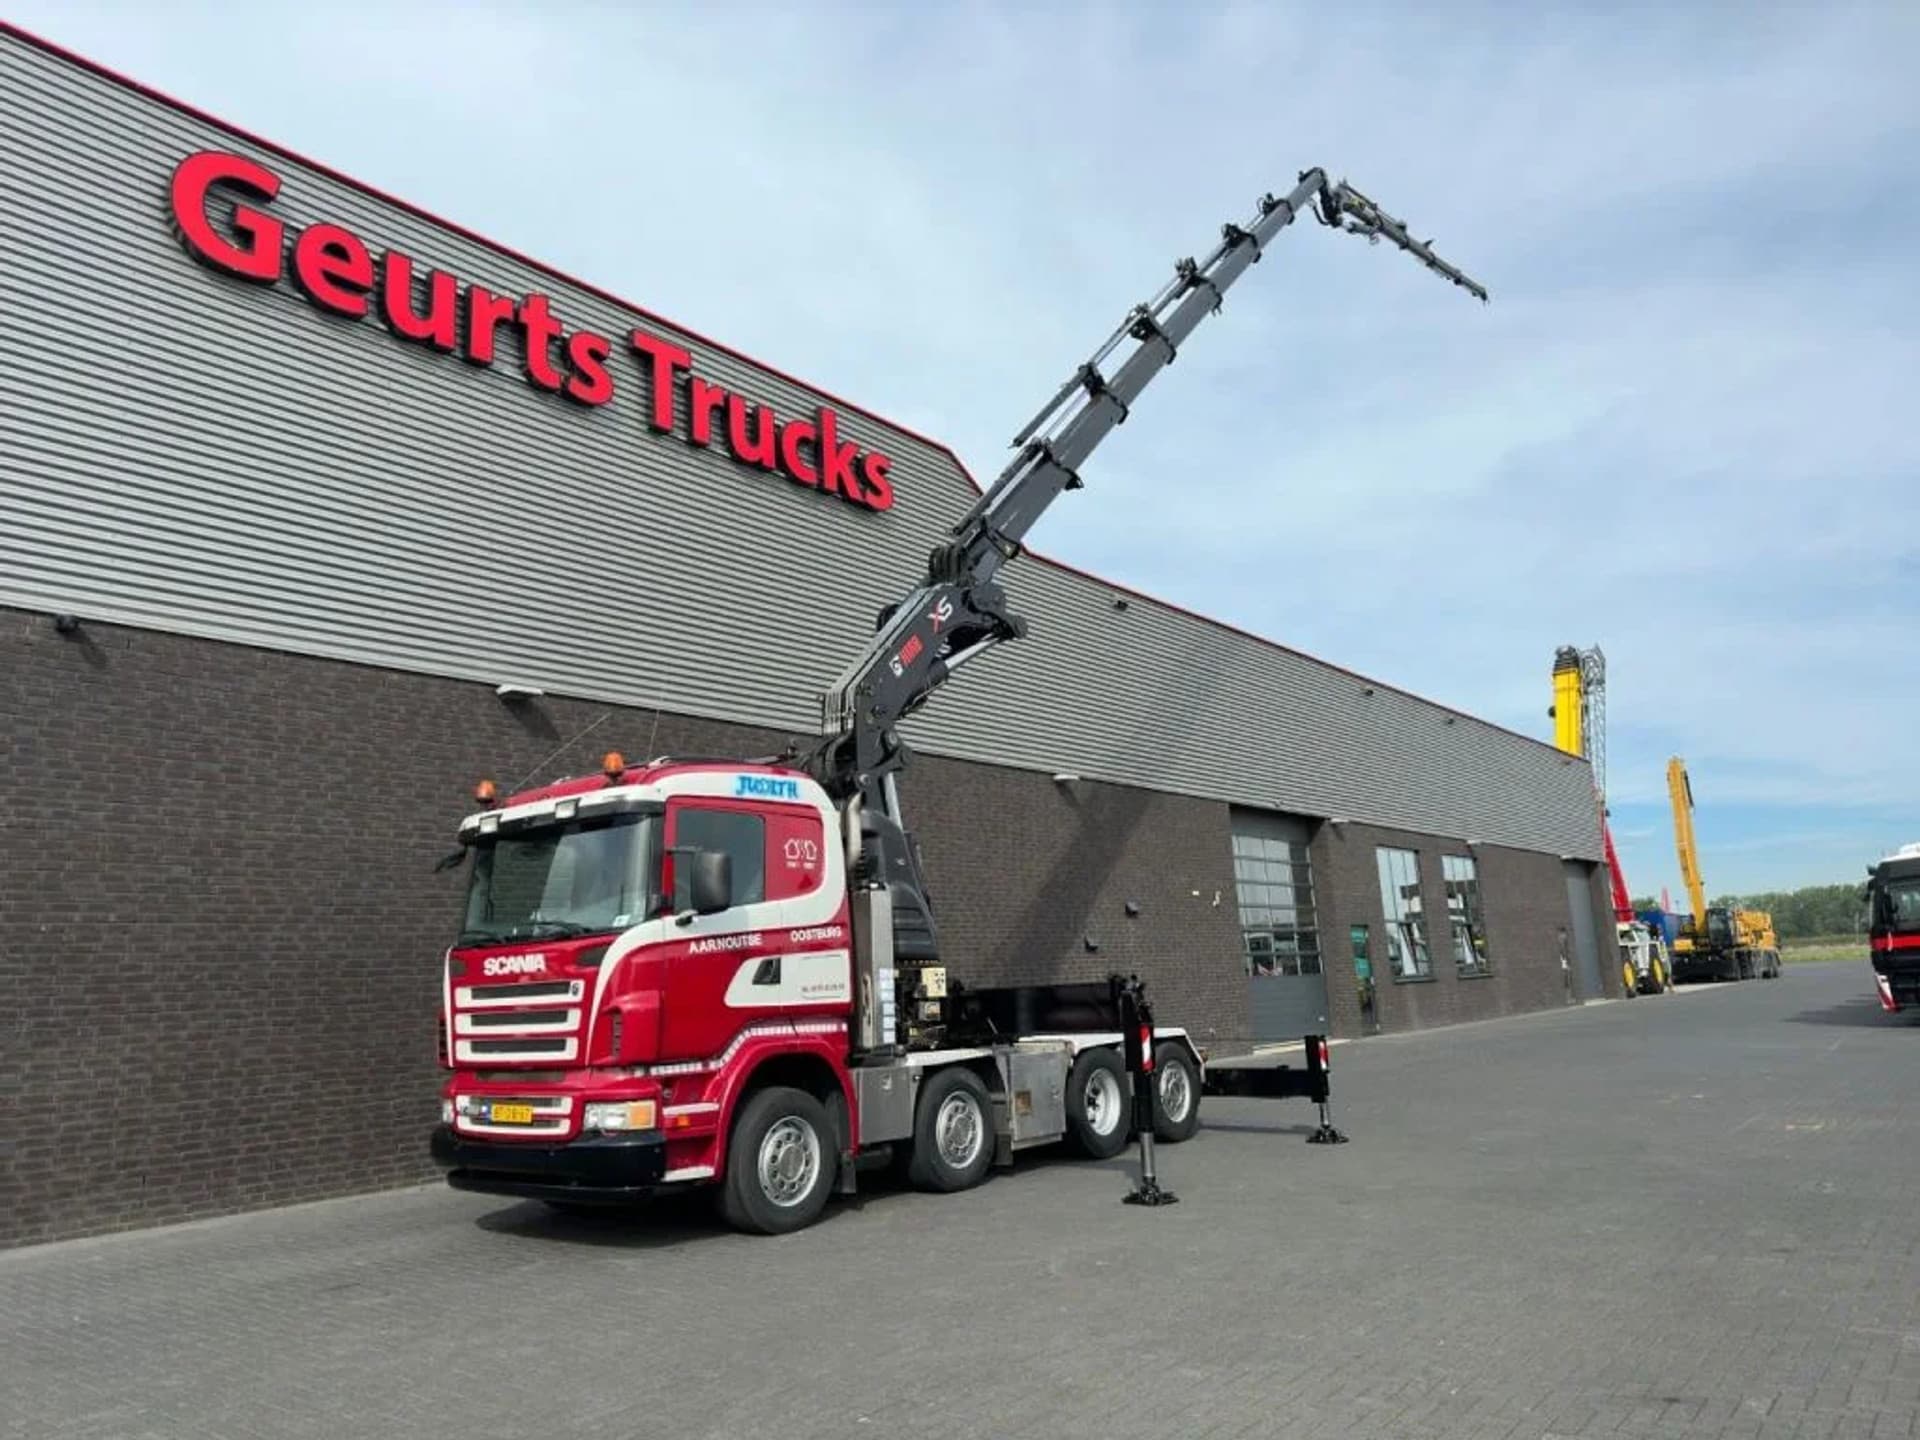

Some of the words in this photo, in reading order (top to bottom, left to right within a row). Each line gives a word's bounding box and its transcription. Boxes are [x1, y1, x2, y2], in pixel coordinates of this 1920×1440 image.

[171, 151, 614, 405] Geurts
[629, 330, 895, 511] Trucks
[790, 926, 842, 943] OOSTBURG
[483, 953, 546, 976] SCANIA
